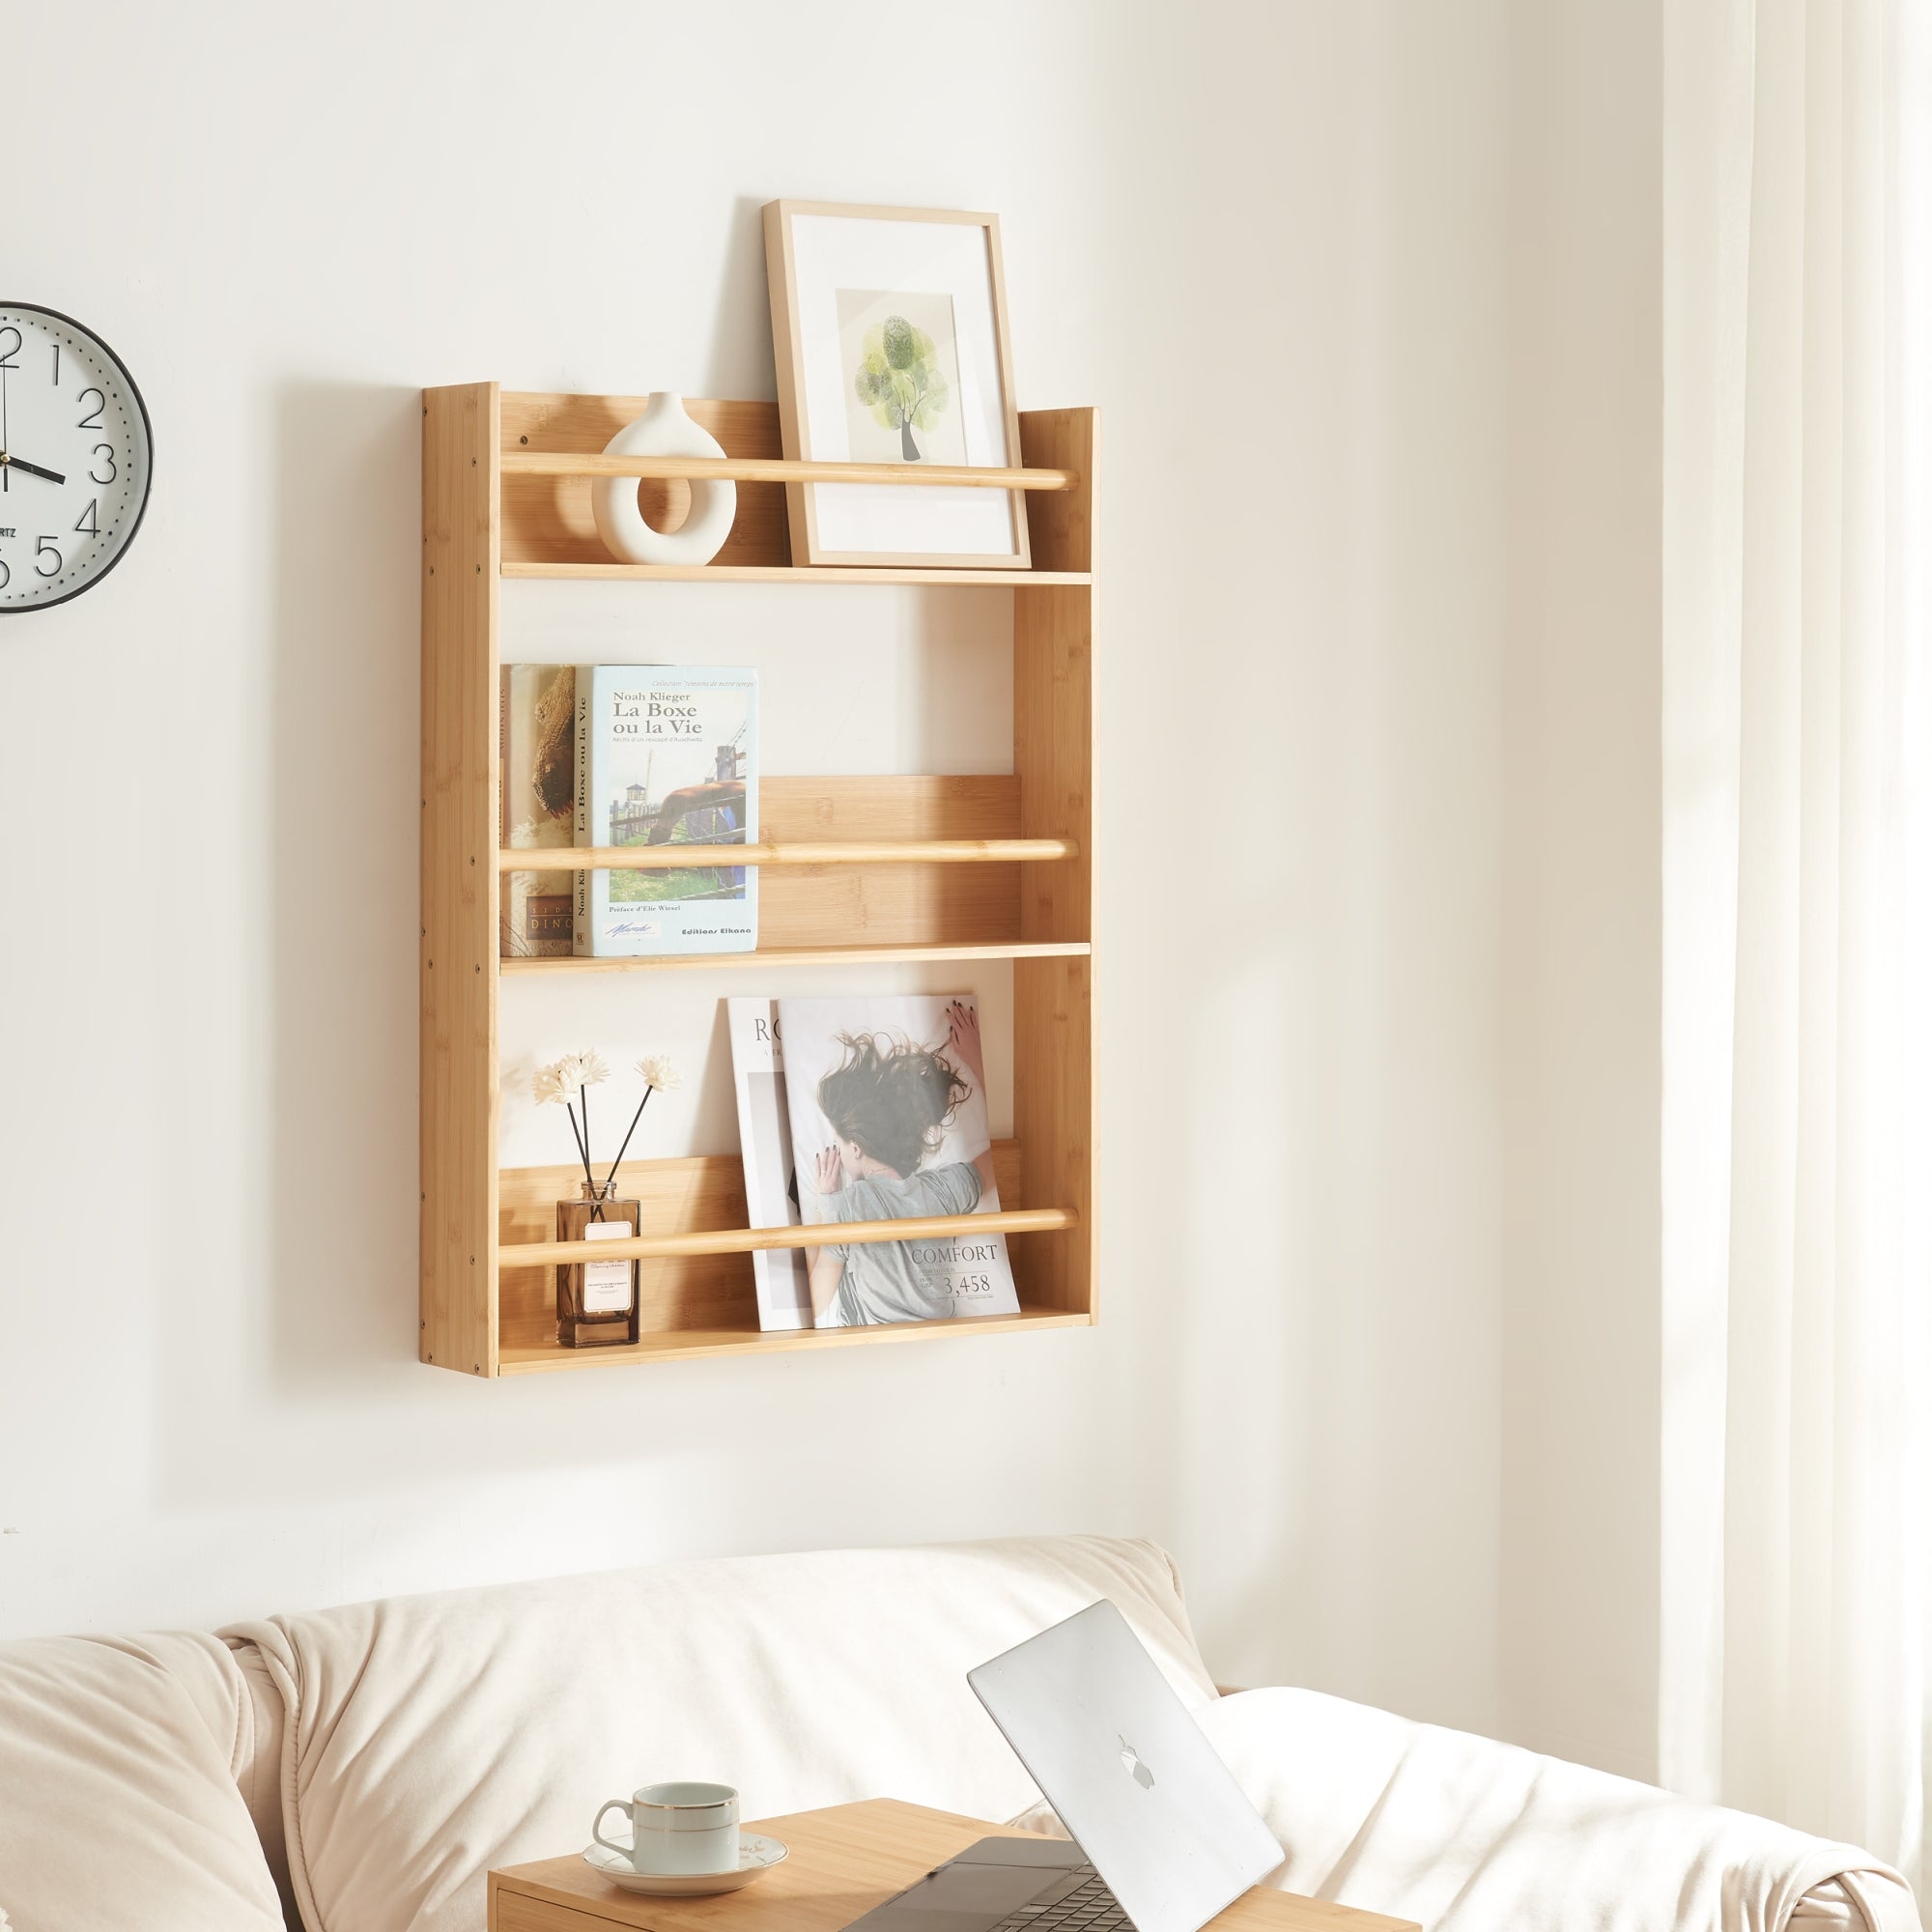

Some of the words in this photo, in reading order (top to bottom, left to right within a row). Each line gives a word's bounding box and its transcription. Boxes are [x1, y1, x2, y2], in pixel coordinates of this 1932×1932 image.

[0, 327, 22, 369] 2
[52, 345, 59, 386] 1
[78, 387, 105, 429] 2
[90, 443, 117, 484] 3
[74, 498, 101, 538] 4
[0, 527, 16, 537] RTZ
[35, 536, 62, 577] 5
[613, 692, 645, 701] Noah
[649, 692, 691, 703] Klieger
[612, 702, 639, 717] La
[647, 702, 697, 717] Boxe
[580, 727, 585, 741] la
[612, 723, 639, 734] ou
[645, 720, 663, 734] la
[669, 719, 702, 734] Vie
[581, 746, 585, 765] ou
[578, 813, 585, 833] La
[911, 1244, 997, 1264] COMFORT
[943, 1274, 990, 1297] 3,458
